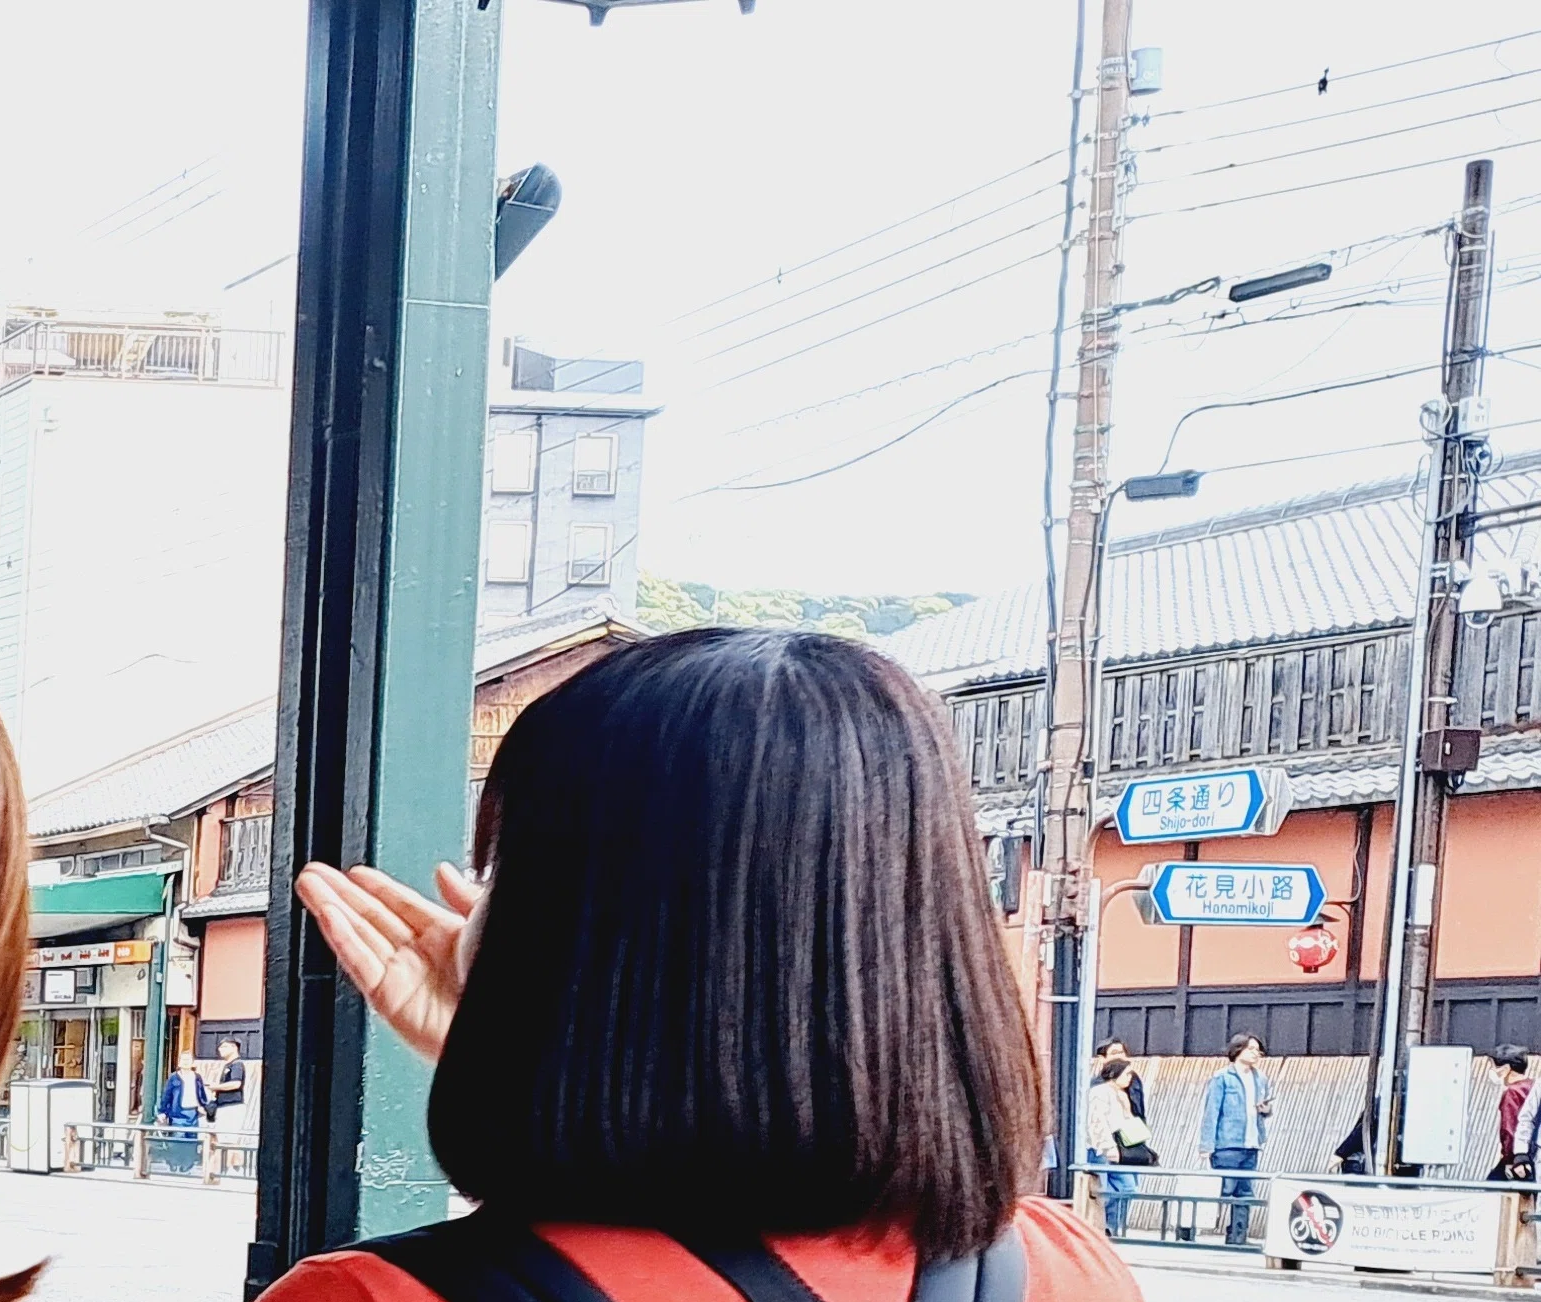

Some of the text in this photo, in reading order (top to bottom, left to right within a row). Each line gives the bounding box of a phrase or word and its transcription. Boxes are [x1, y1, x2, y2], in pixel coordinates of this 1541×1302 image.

[1142, 781, 1236, 816] 四条通り
[1160, 812, 1215, 833] Shijo-dori
[1185, 873, 1294, 901] 花見小路
[1202, 901, 1275, 918] Hanamikoji
